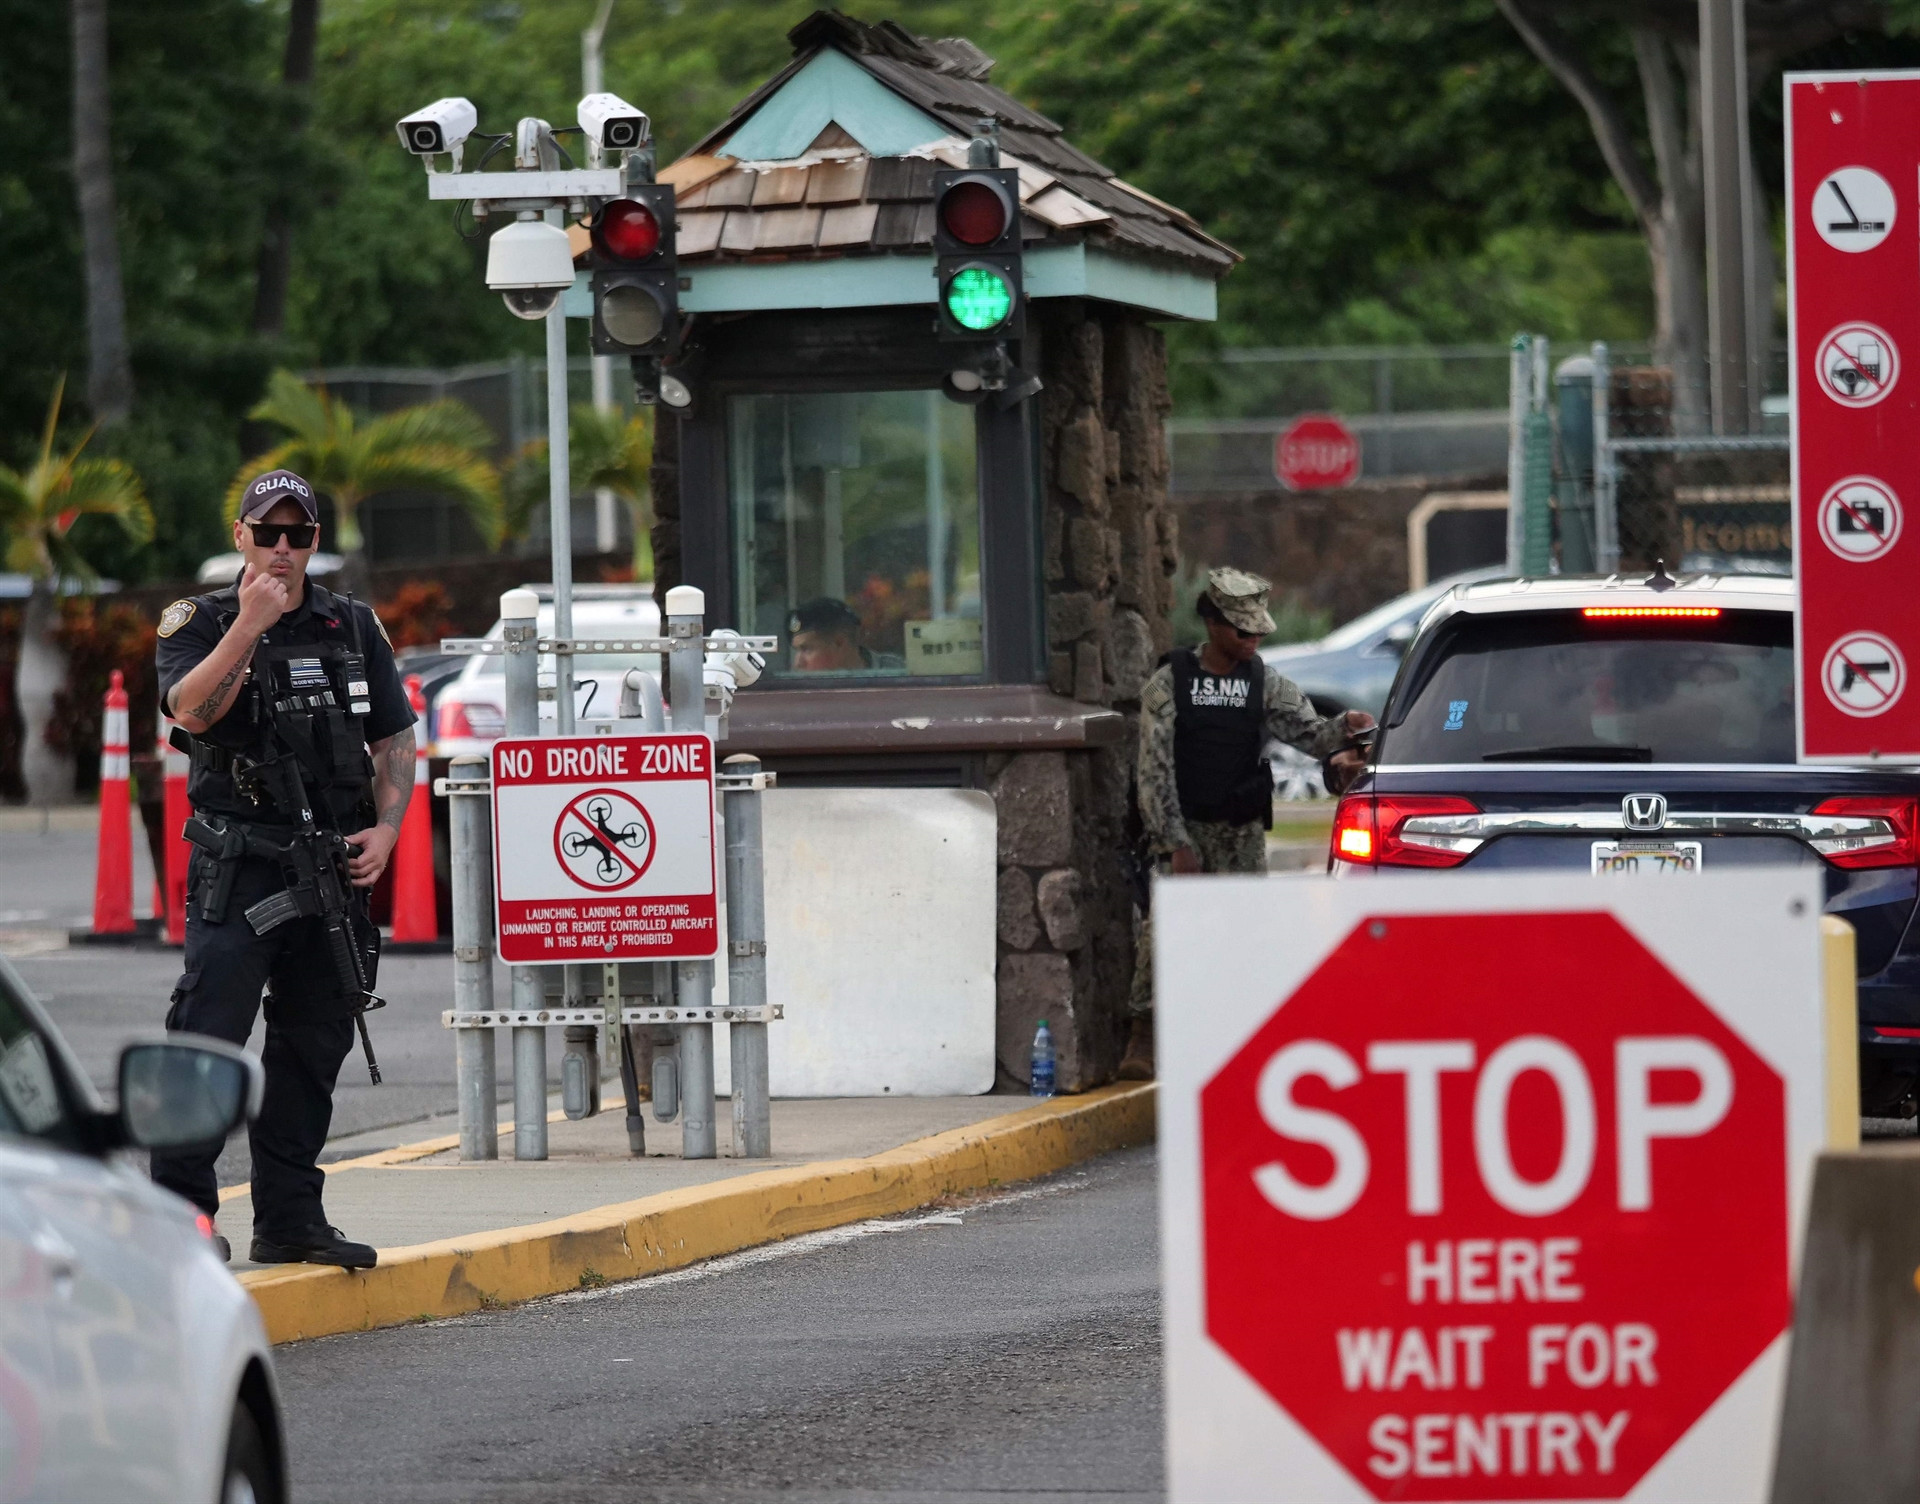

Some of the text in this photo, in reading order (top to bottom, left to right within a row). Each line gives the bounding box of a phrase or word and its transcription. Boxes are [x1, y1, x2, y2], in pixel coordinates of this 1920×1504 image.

[1283, 442, 1356, 474] STOP
[255, 476, 309, 498] GUARD
[500, 743, 704, 778] NO DRONE ZONE
[502, 917, 714, 935] UNMANNED OR REMOTE CONTROLLED AIRCRAFT
[526, 903, 690, 920] LAUNCHING, LANDING OR OPERATING
[544, 932, 673, 948] IN THIS AREA IS PROHIBITED
[1251, 1034, 1736, 1221] STOP
[1406, 1236, 1585, 1305] HERE
[1336, 1321, 1659, 1392] WAIT FOR
[1366, 1409, 1633, 1479] SENTRY
